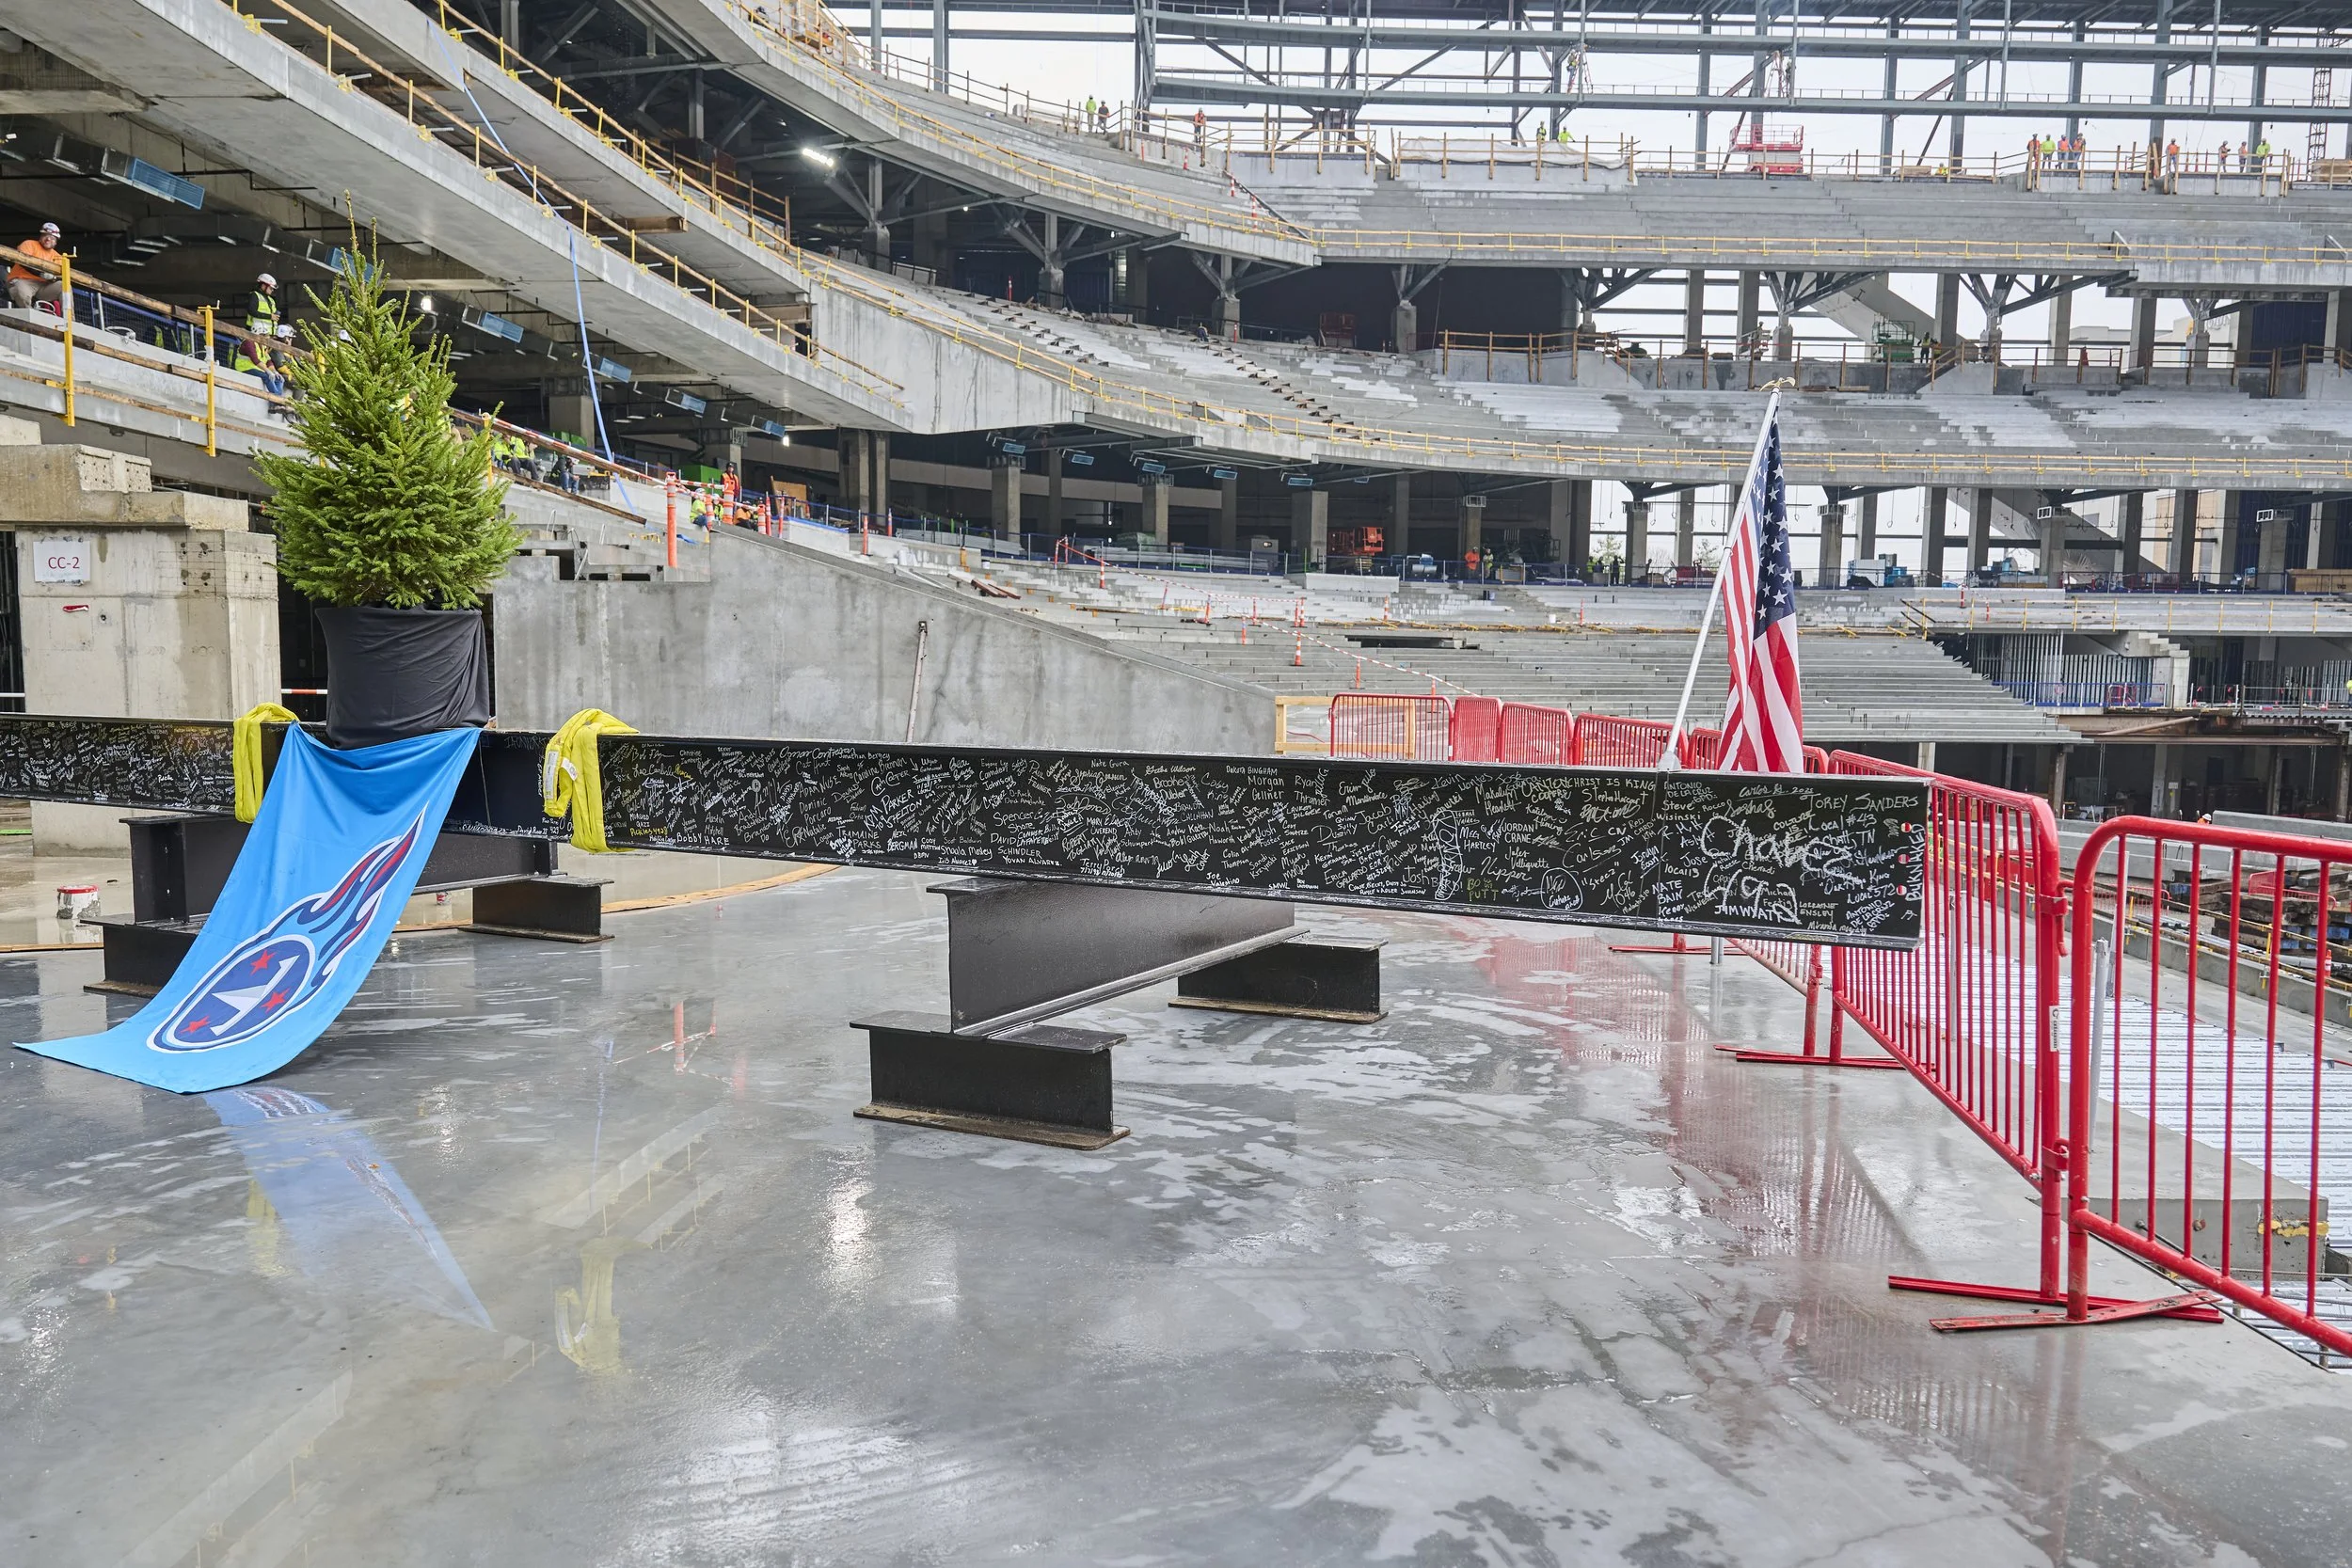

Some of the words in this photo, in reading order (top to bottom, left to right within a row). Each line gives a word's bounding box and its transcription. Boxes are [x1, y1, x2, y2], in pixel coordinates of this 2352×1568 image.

[48, 556, 80, 569] CC-2
[1090, 758, 1105, 768] Nate
[1248, 766, 1279, 776] BINGHAM
[1152, 775, 1185, 789] Brooke
[1248, 774, 1284, 792] Morgan
[1295, 774, 1317, 790] Ryan
[1567, 778, 1601, 789] CHRIST
[1605, 779, 1620, 787] IS
[1625, 778, 1657, 792] KING
[1251, 787, 1285, 801] Gellner
[799, 798, 827, 815] Dominic
[881, 789, 915, 815] PARKER
[1661, 800, 1694, 812] Steve
[1701, 800, 1725, 813] Rocco
[1799, 793, 1849, 813] TOREY
[1849, 792, 1920, 814] SANDERS
[804, 806, 831, 826] Porcaro
[993, 811, 1034, 827] Spencer
[1355, 803, 1392, 827] Jacob
[1656, 811, 1701, 822] Wisinski
[744, 821, 773, 843] Brandon
[1008, 822, 1035, 834] Shore
[1207, 819, 1231, 834] Noah
[1502, 821, 1535, 833] JORDAN
[705, 835, 730, 846] HARE
[852, 838, 882, 849] PARKS
[990, 832, 1017, 845] DAVID
[1504, 832, 1532, 845] CRANE
[1855, 828, 1876, 846] TN
[997, 846, 1042, 859] SCHINDLER
[1222, 847, 1240, 859] Colin
[1463, 839, 1496, 853] HARTLEY
[1003, 855, 1025, 865] YOVAN
[1679, 851, 1708, 868] Jose
[1205, 871, 1221, 881] Joe
[1402, 863, 1431, 885] Josh
[1651, 879, 1683, 895] NATE
[1657, 890, 1684, 905] BAIN
